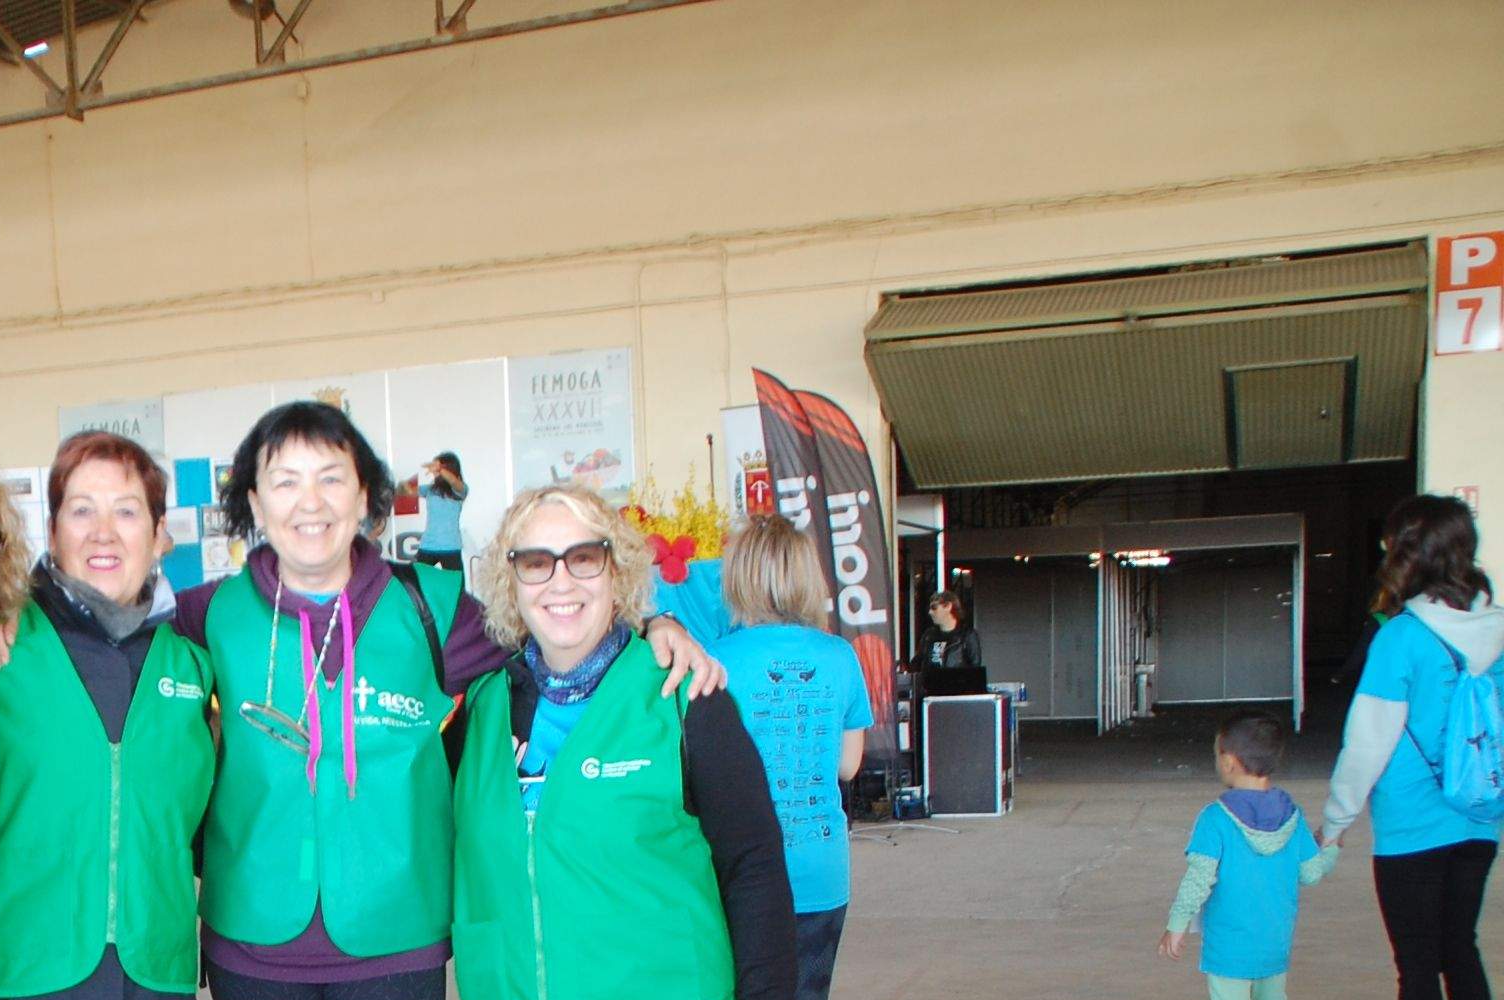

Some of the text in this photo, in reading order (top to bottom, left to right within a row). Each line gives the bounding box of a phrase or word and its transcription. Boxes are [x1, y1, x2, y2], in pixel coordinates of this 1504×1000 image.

[1450, 236, 1496, 285] P
[1457, 298, 1483, 345] 7
[531, 369, 602, 395] FEMOGA
[82, 418, 141, 437] MOGA
[377, 691, 424, 716] aecc
